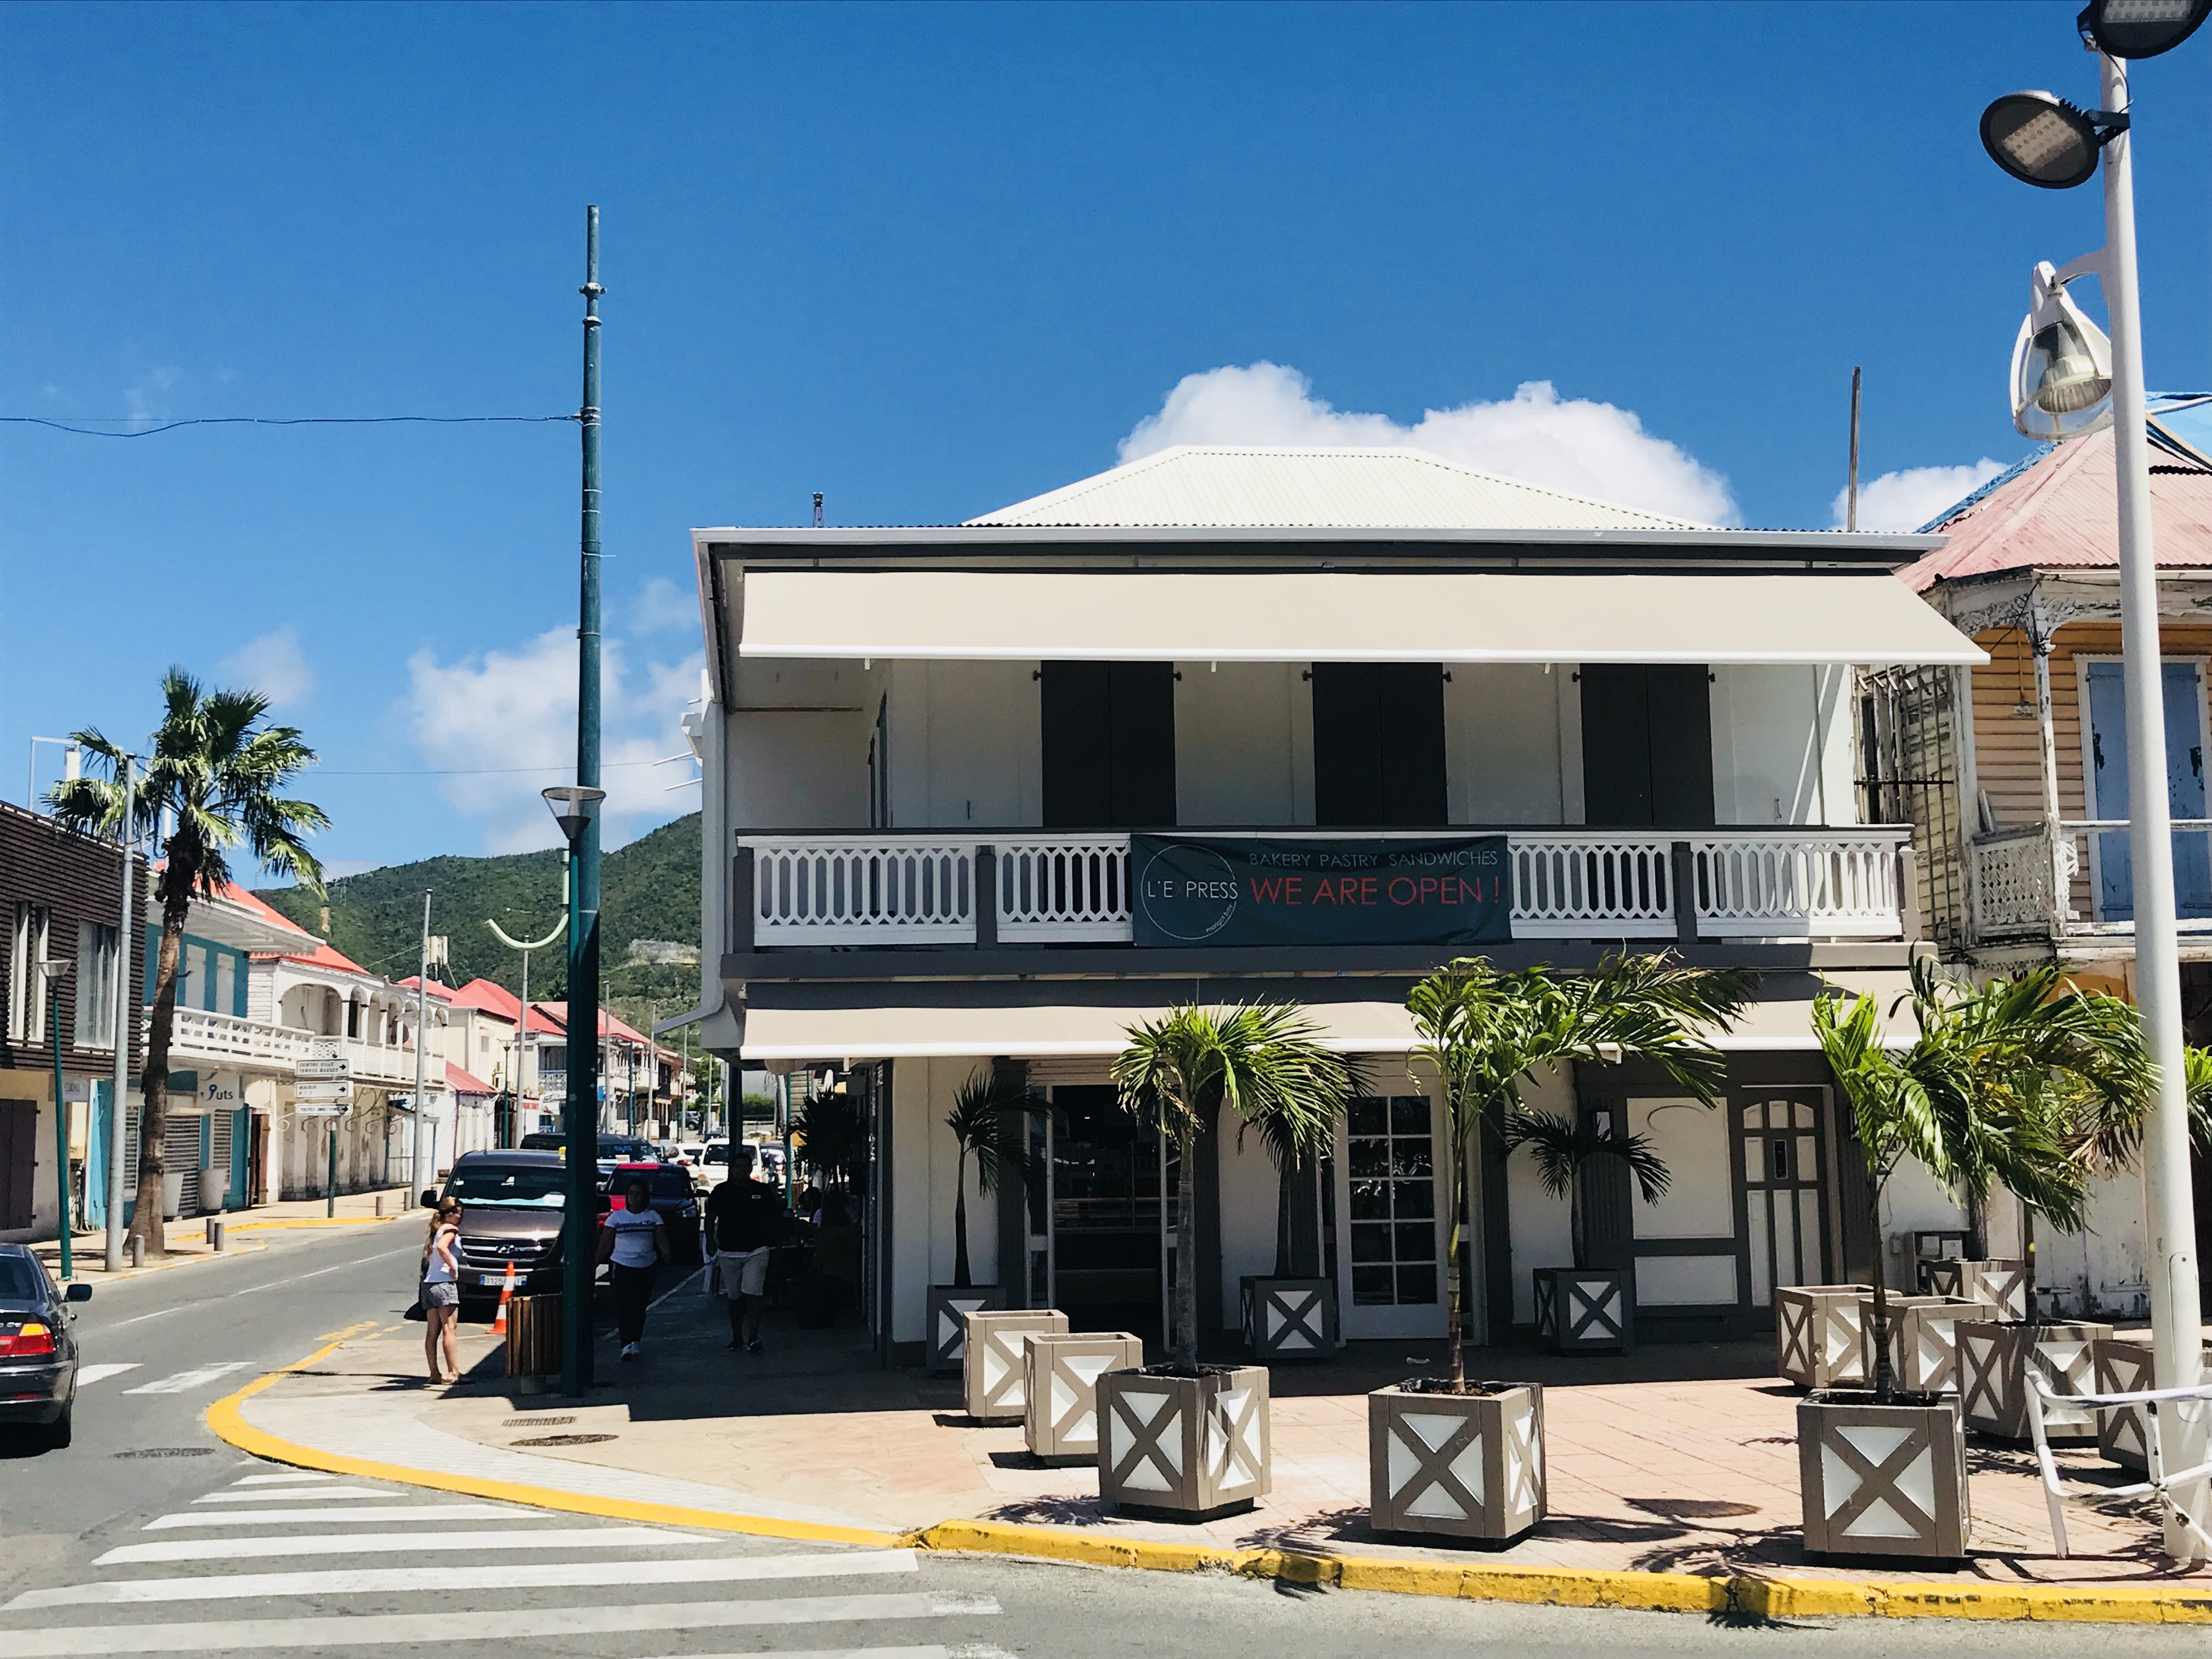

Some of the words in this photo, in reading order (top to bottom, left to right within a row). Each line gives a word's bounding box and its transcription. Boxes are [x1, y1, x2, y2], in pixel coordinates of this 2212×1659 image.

[1249, 853, 1311, 867] BAKERY
[1319, 854, 1378, 867] PASTRY
[1389, 851, 1498, 866] SANDWICHES
[1250, 877, 1302, 905] WE
[1312, 878, 1377, 905] ARE
[1388, 877, 1482, 905] OPEN
